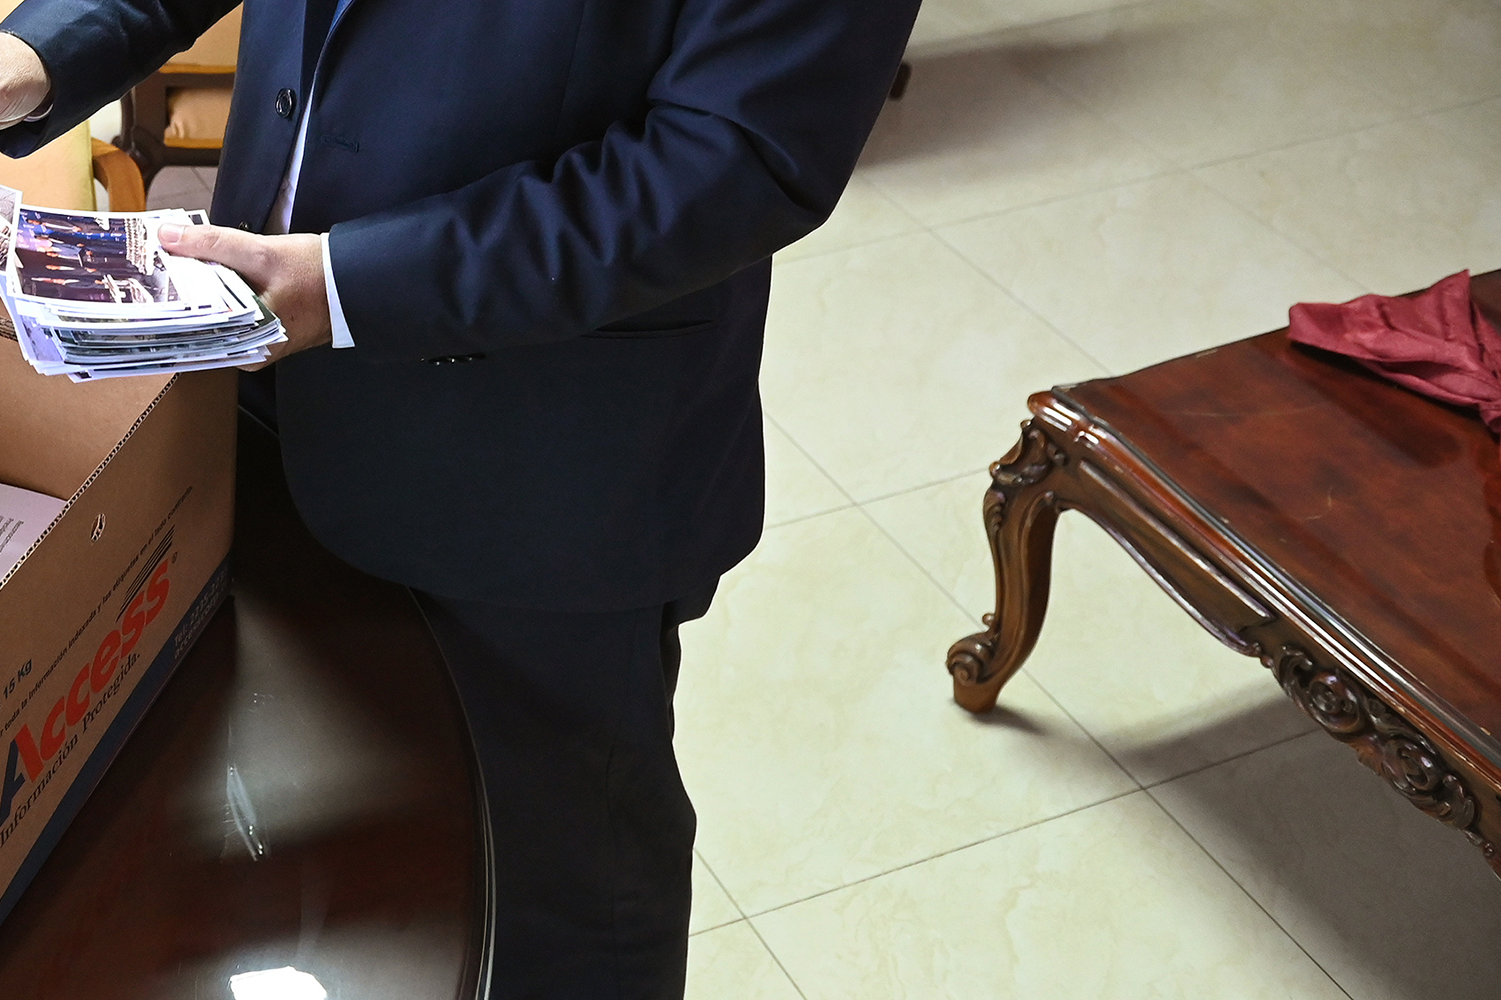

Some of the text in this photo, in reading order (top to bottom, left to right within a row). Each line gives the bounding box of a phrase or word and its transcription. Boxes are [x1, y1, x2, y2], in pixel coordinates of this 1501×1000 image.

[3, 677, 16, 699] 15
[17, 659, 33, 682] Kg
[4, 709, 20, 731] toda
[21, 699, 28, 710] la
[0, 652, 141, 849] Información Protegida.
